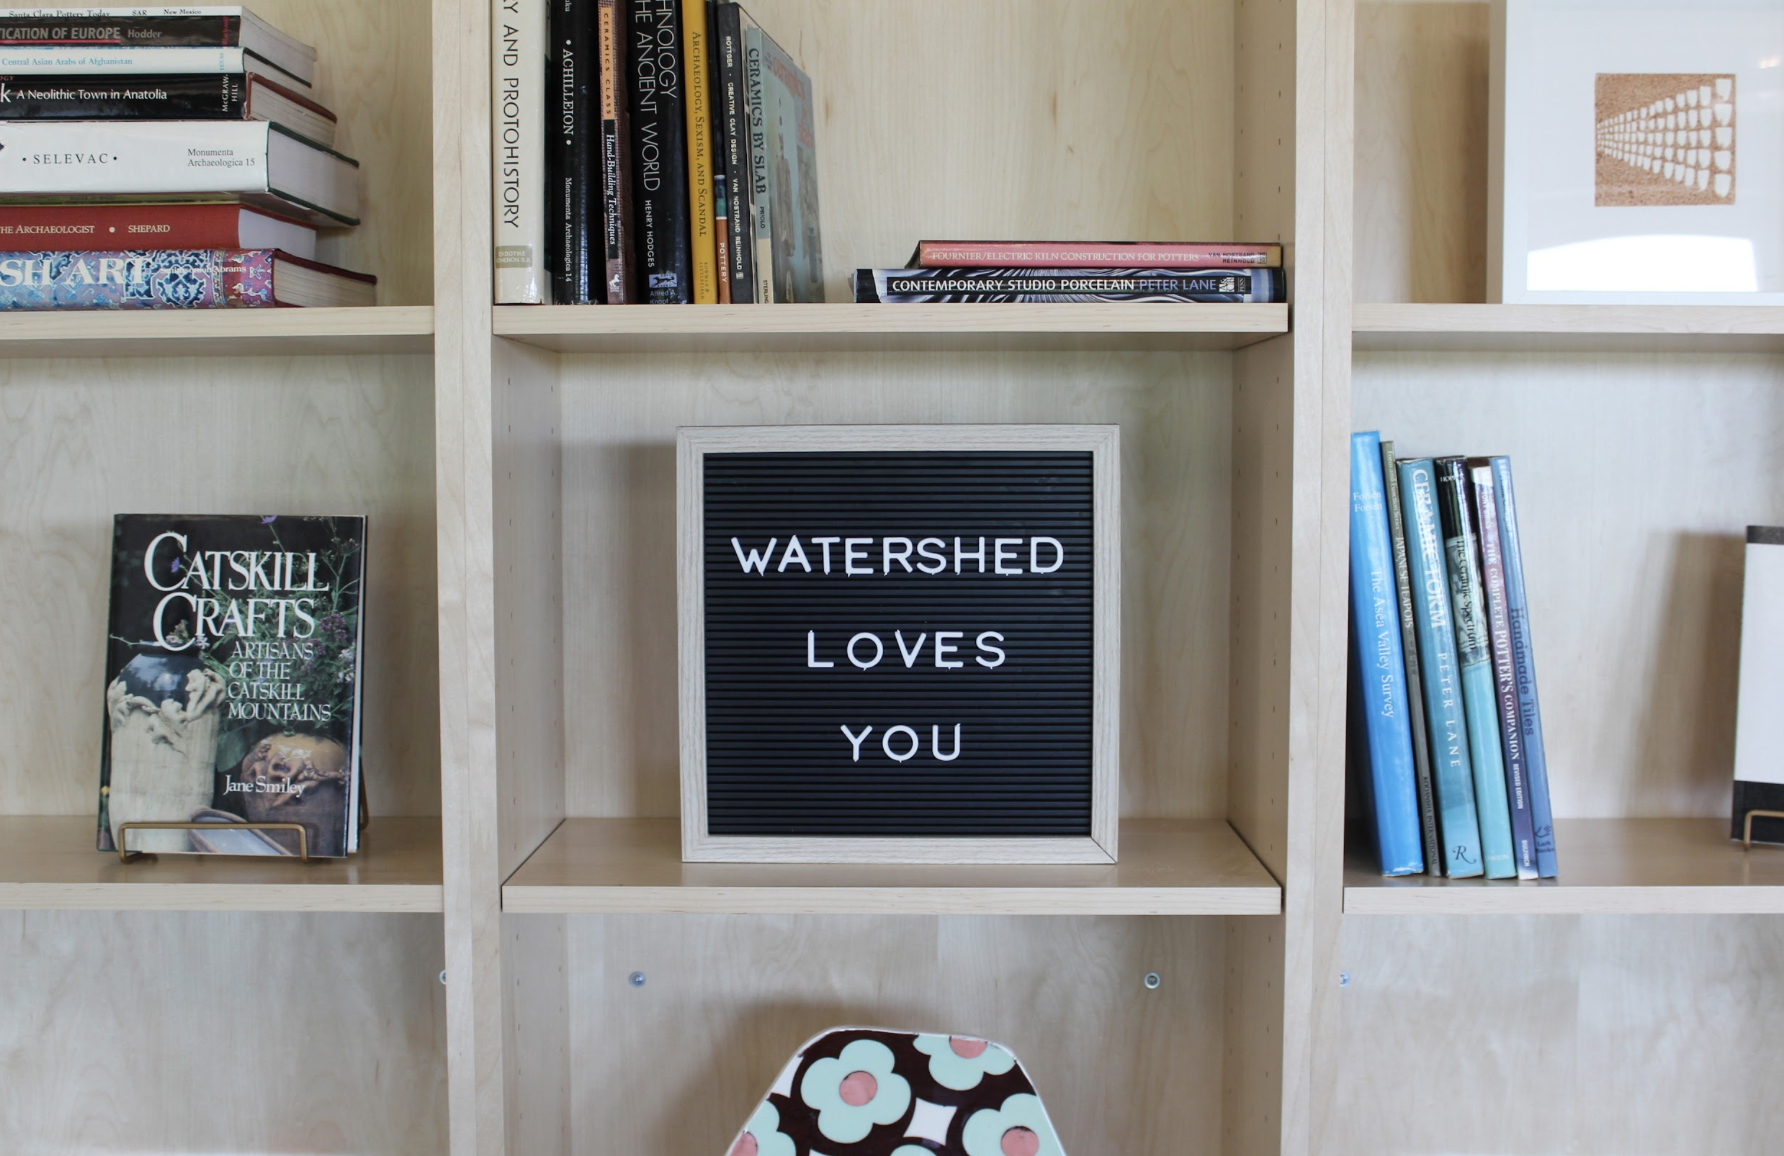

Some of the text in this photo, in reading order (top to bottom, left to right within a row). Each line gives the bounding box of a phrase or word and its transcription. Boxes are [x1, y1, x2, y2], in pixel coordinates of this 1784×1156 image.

[0, 27, 120, 40] ICATION OF EUROPE
[33, 10, 54, 18] Clara
[128, 29, 162, 38] Hodder
[603, 12, 611, 72] CERAMICS
[2, 58, 133, 67] Central Asian Arabs of Afghanistan
[636, 31, 658, 114] ANCIENT
[16, 90, 25, 100] A
[28, 88, 76, 100] Neolithic
[78, 90, 108, 100] Town
[110, 88, 120, 100] in
[122, 88, 168, 100] Anatolia
[562, 48, 574, 136] ACHILLEION
[728, 82, 736, 115] CREATIVE
[748, 48, 763, 127] CERAMICS
[503, 0, 520, 228] Y AND PROTOHISTORY
[729, 118, 737, 136] CLAY
[34, 153, 109, 164] SELEVAC
[188, 148, 234, 156] Monumenta
[640, 122, 661, 192] WORLD
[752, 132, 765, 150] BY
[188, 158, 256, 168] Archaeologica 15
[754, 155, 767, 194] SLAB
[606, 134, 617, 246] Hand-Building Techniques
[15, 225, 95, 234] ARCHAEOLOGIST
[128, 224, 171, 233] SHEPARD
[697, 188, 708, 238] SCANDAL
[733, 196, 741, 234] NOSTRAND
[564, 222, 573, 272] Archaeologica
[644, 200, 655, 268] HENRY HODGES
[735, 236, 743, 270] REINHOLD
[66, 258, 152, 285] ART
[720, 242, 728, 282] POTTERY
[1035, 252, 1059, 260] KILN
[1060, 252, 1136, 261] CONSTRUCTION
[1138, 252, 1156, 262] FOR
[1158, 252, 1200, 262] POTTERS
[565, 273, 572, 282] 14
[892, 280, 1004, 291] CONTEMPORARY
[1008, 280, 1056, 291] STUDIO
[1060, 279, 1134, 291] PORCELAIN
[1140, 279, 1178, 290] PETER
[1183, 279, 1216, 290] LANE
[144, 532, 330, 592] CATSKILL
[730, 534, 1064, 576] WATERSHED
[1425, 568, 1446, 628] FORM
[1490, 568, 1504, 628] COMPLETE
[153, 592, 316, 652] CRAFTS
[1461, 600, 1478, 650] Spectrum
[232, 640, 314, 660] ARTISANS
[807, 630, 1006, 670] LOVES
[1371, 568, 1394, 718] The Asea Valley Survey
[1494, 630, 1514, 693] POTTER'S
[229, 661, 291, 680] OF THE
[1510, 606, 1536, 736] Handmade Tiles
[228, 681, 305, 700] CATSKILL
[1438, 652, 1461, 768] PETER LANE
[228, 702, 332, 722] MOUNTAINS
[1504, 694, 1520, 760] COMPANION
[840, 723, 961, 762] YOU
[222, 774, 306, 798] Jane Smiley
[1512, 764, 1524, 810] REVISED EDITION
[1452, 846, 1477, 864] R
